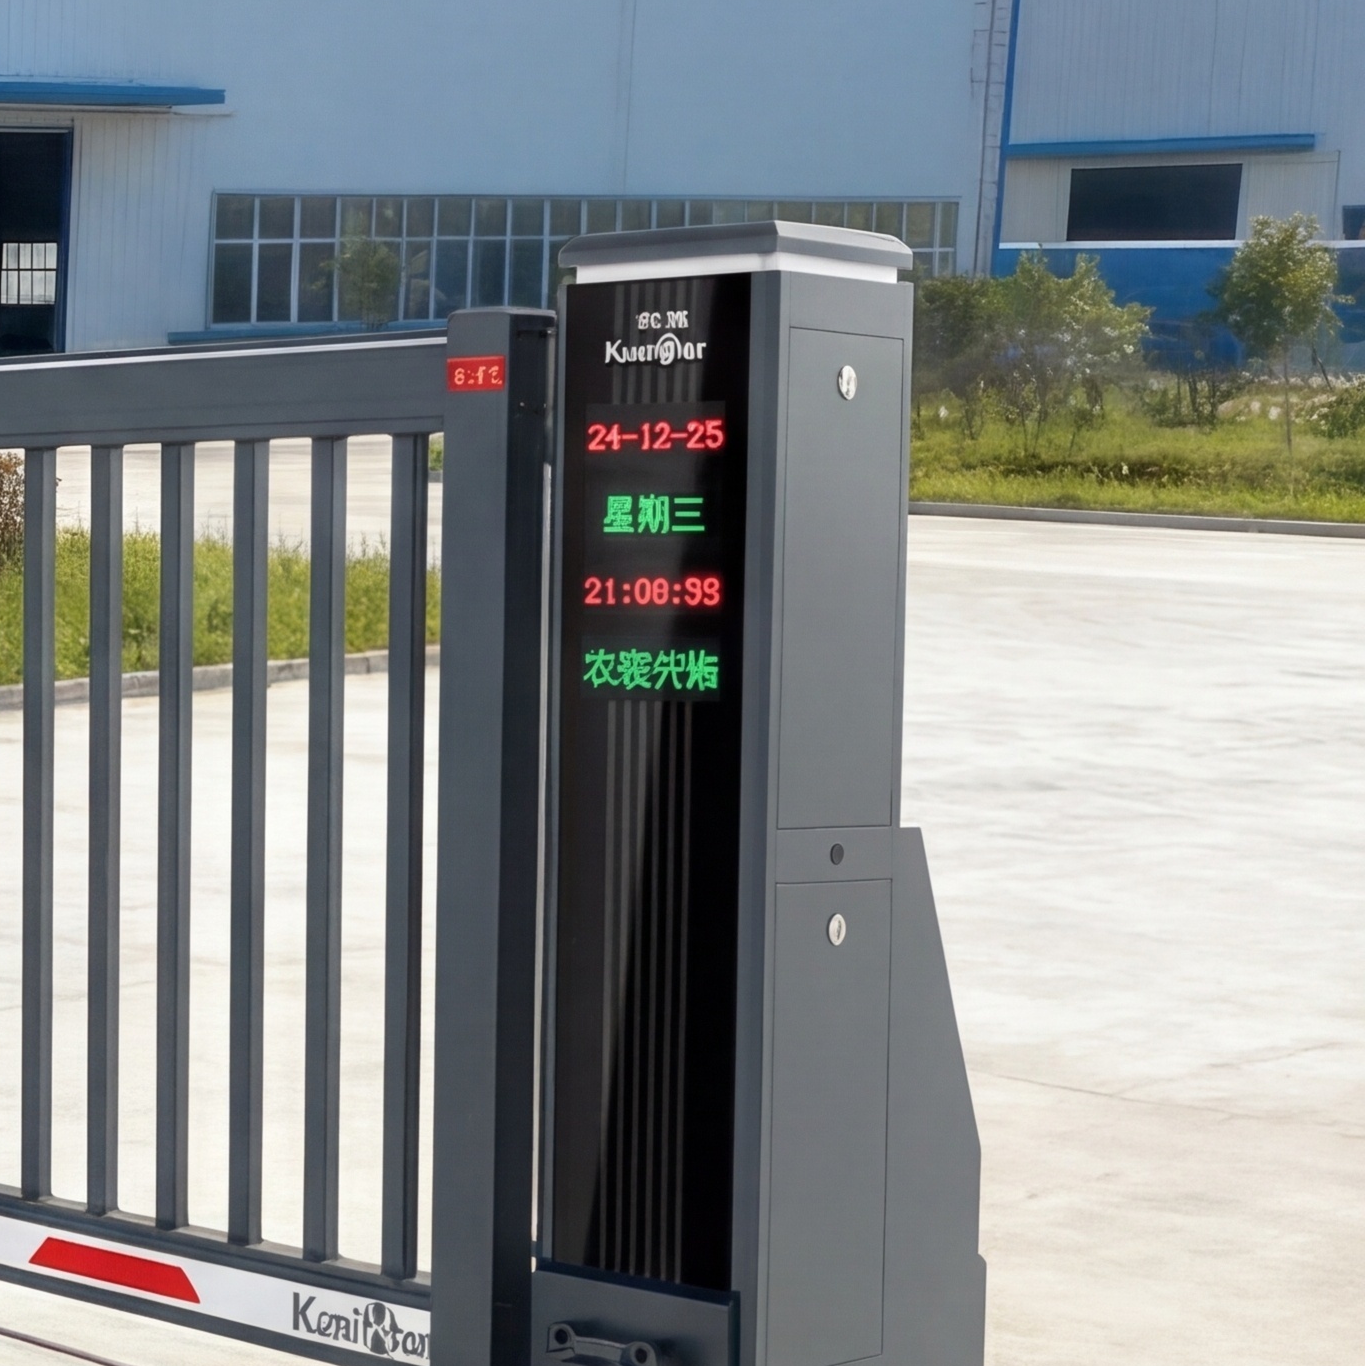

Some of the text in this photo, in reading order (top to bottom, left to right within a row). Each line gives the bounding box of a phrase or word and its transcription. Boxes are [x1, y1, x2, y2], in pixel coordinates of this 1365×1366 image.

[587, 419, 724, 451] 24-12-25
[603, 493, 706, 534] 星期三
